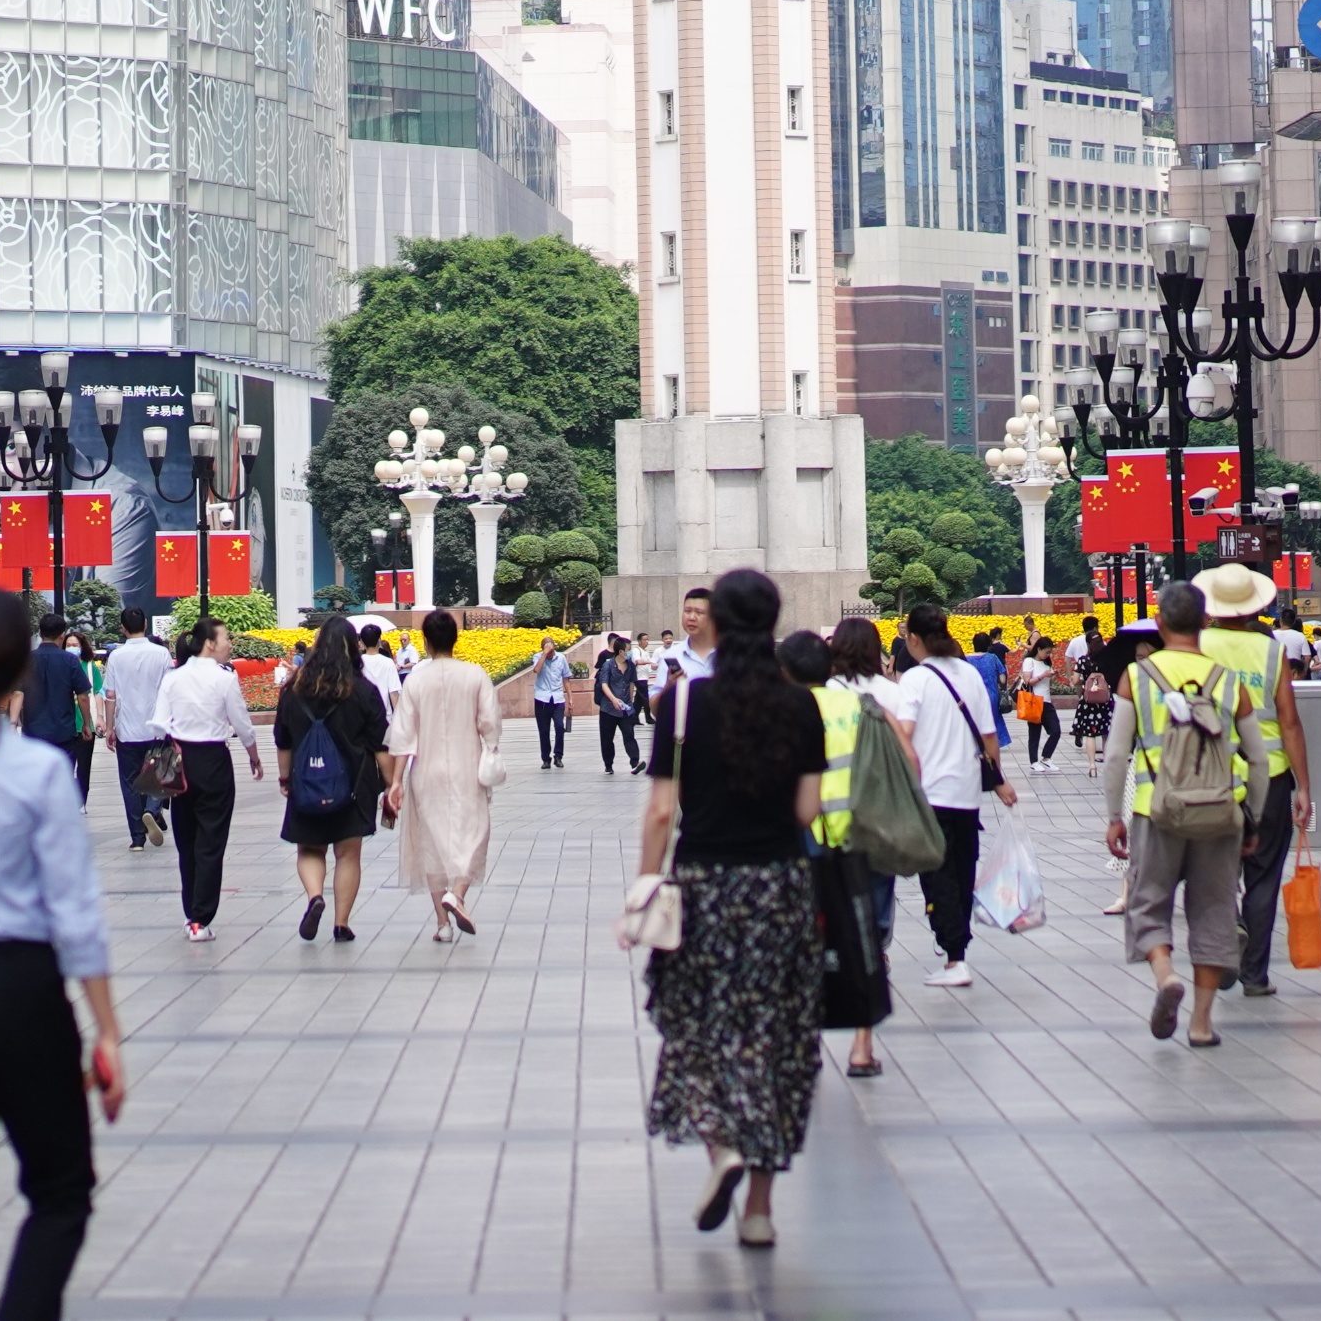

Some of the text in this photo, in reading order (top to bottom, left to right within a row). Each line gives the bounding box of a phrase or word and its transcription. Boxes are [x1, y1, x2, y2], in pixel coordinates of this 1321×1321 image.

[122, 384, 184, 397] 品牌代言人
[146, 405, 184, 417] 李易峰
